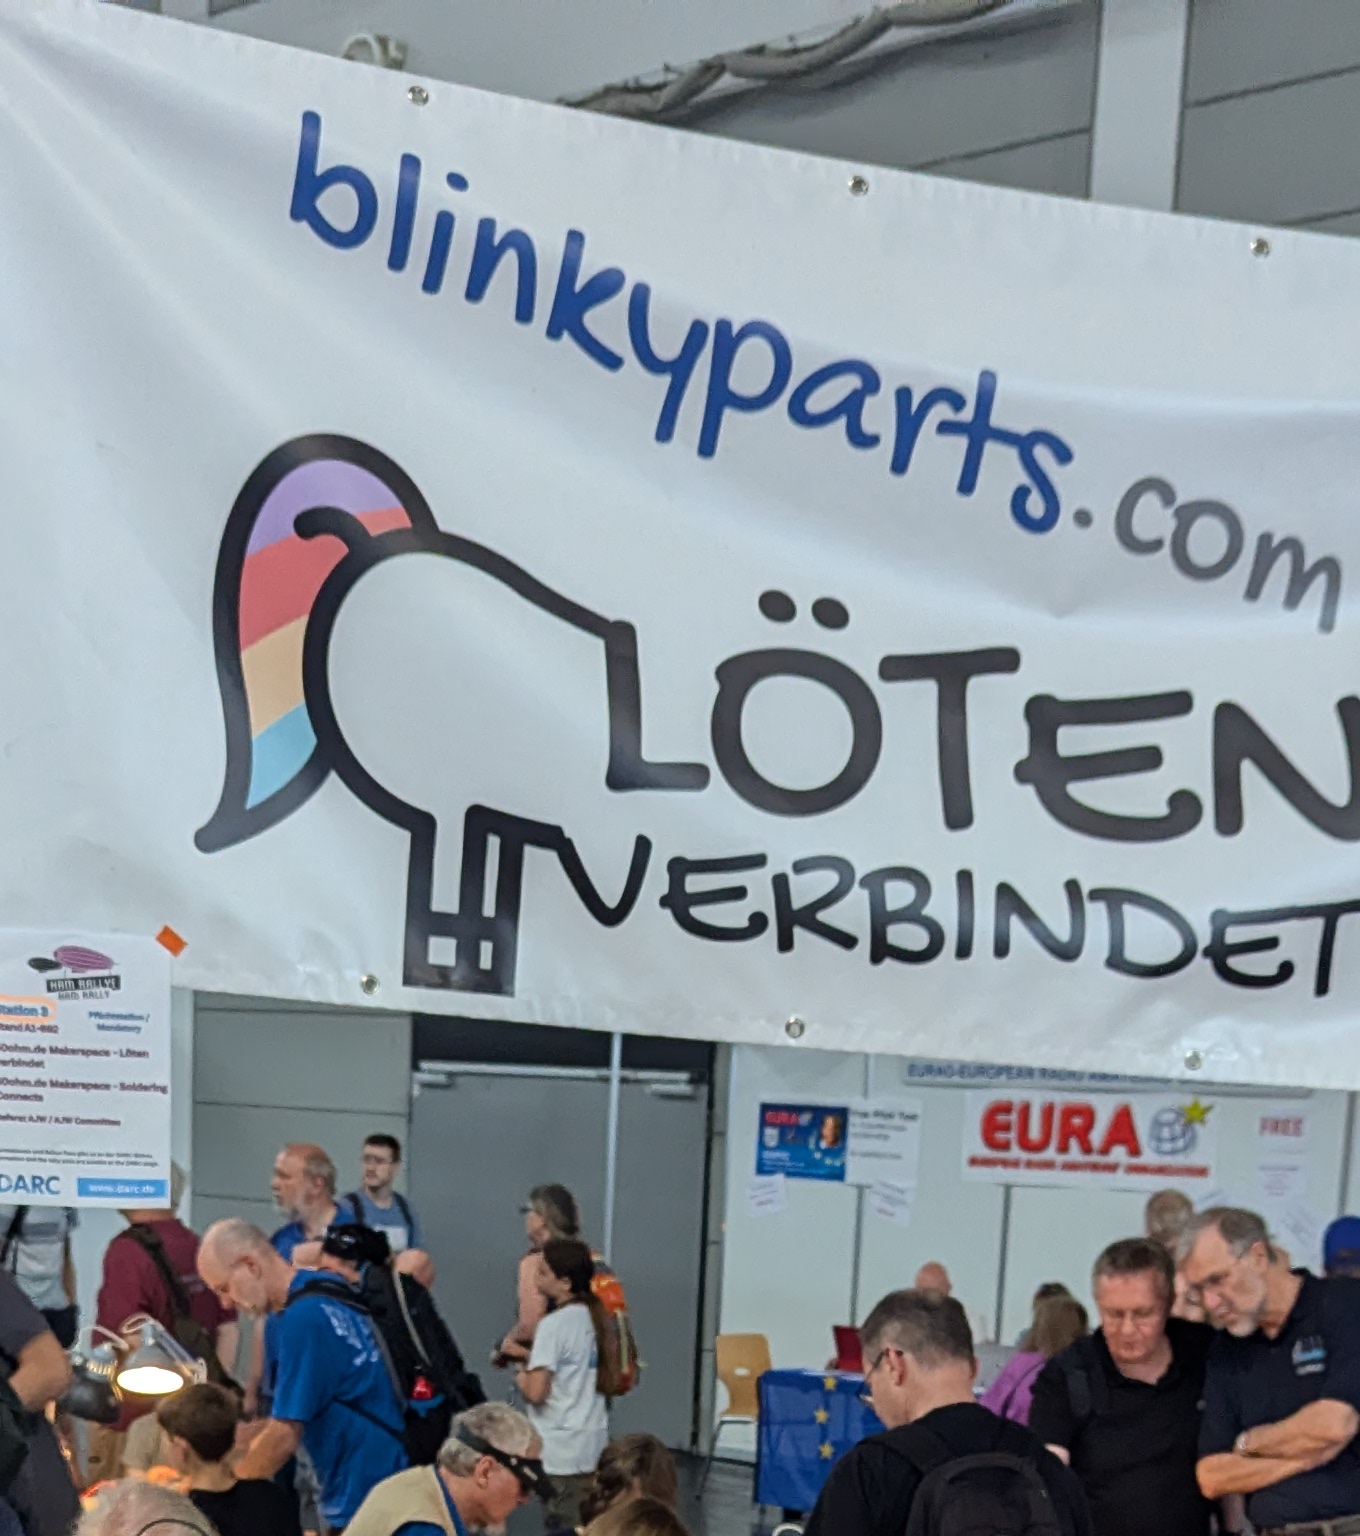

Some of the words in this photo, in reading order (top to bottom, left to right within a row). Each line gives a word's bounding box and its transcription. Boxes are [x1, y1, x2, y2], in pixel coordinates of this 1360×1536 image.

[290, 113, 1342, 633] blinkyparts.com
[50, 1046, 111, 1058] Makerspace
[120, 1048, 149, 1058] Löten
[50, 1079, 111, 1091] Makerspace
